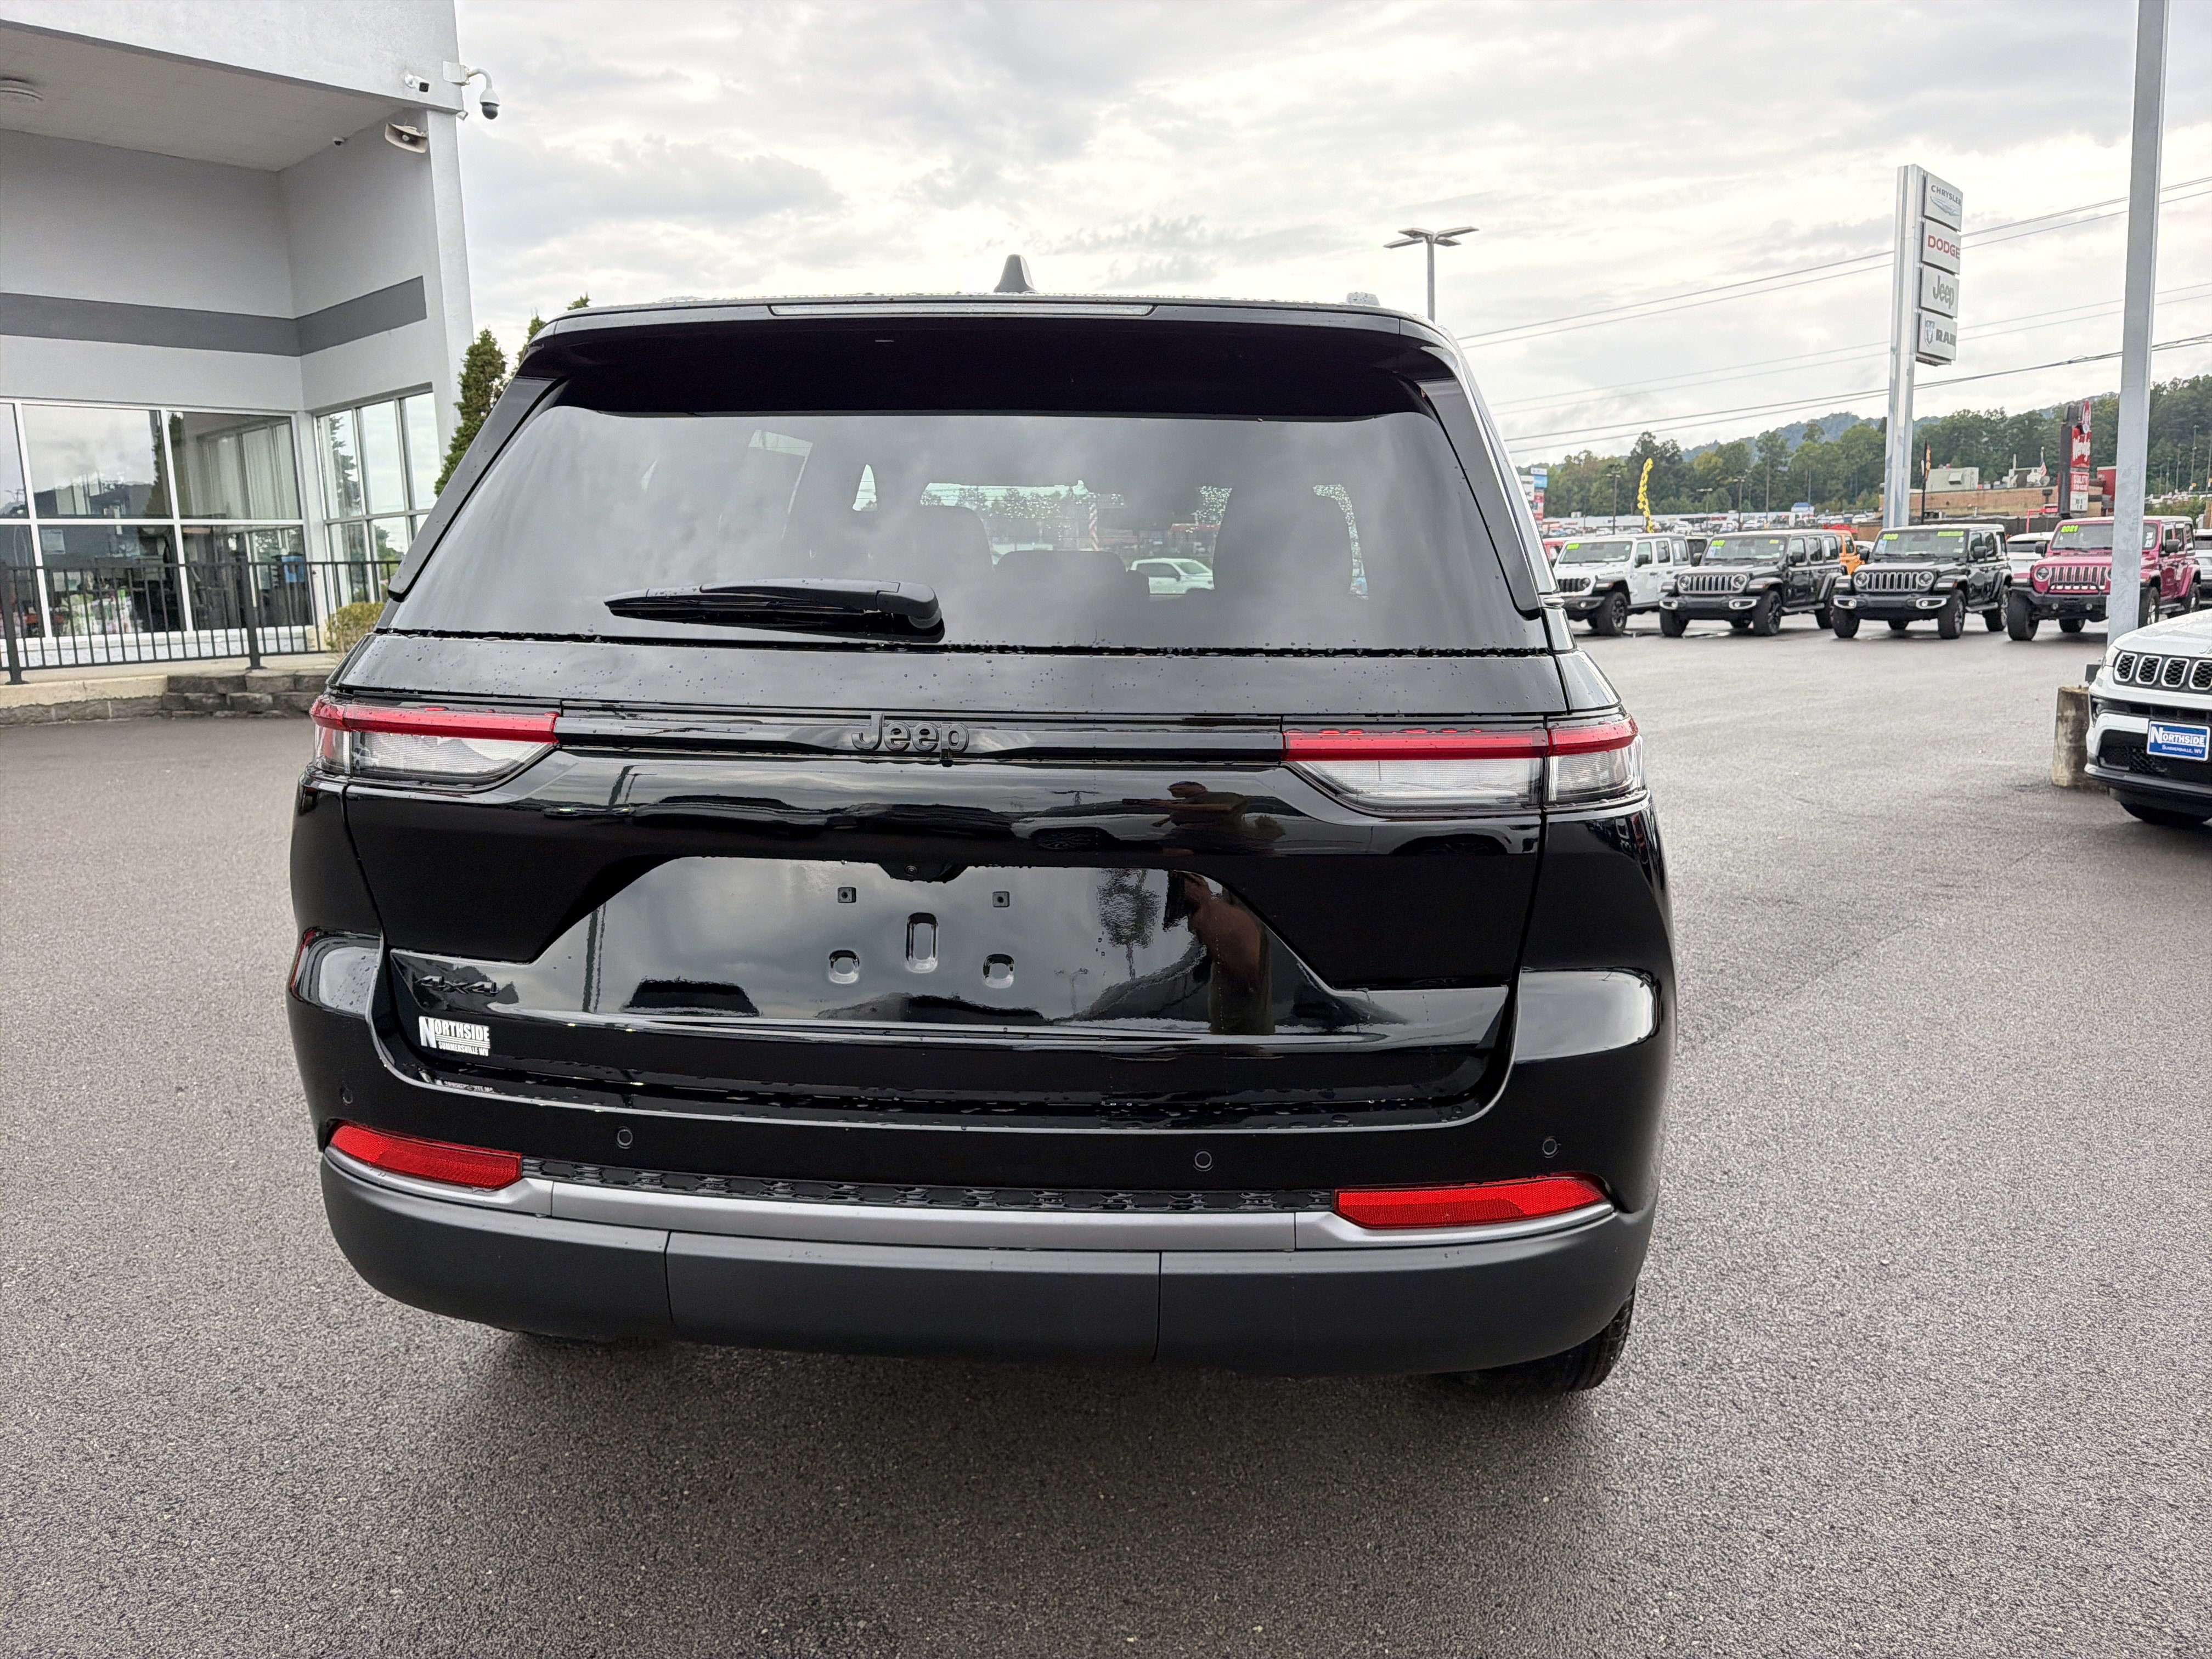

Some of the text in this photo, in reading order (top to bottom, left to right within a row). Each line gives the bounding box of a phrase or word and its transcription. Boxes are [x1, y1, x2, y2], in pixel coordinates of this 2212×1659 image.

[1931, 185, 1961, 206] CHRYSLER
[1928, 235, 1960, 259] DODGE
[1933, 275, 1954, 309] Jeep
[1936, 329, 1956, 347] RAM
[851, 713, 969, 761] Jeep
[2151, 726, 2205, 745] NORTHSIDE
[419, 1015, 490, 1048] NORTHSIDE
[438, 1041, 489, 1057] SUMMERSVILLE WV
